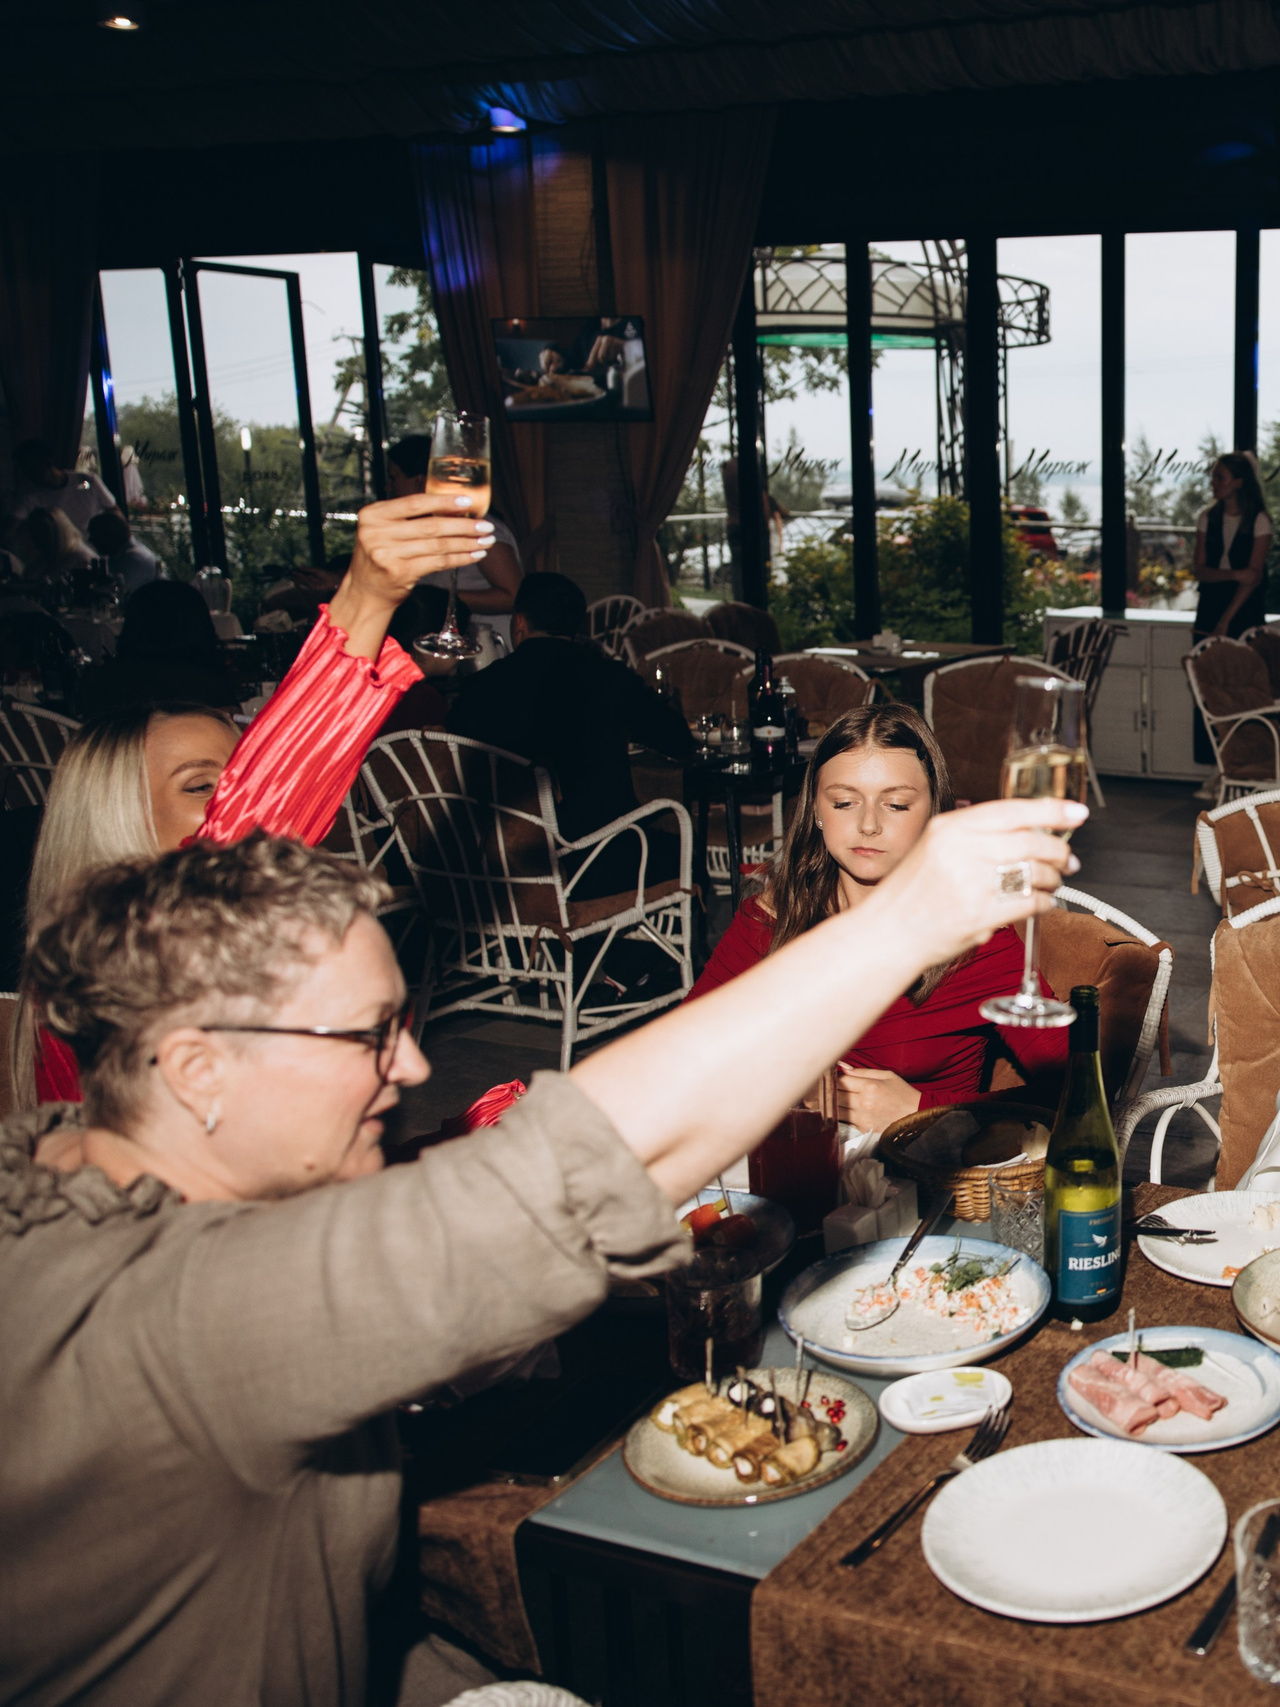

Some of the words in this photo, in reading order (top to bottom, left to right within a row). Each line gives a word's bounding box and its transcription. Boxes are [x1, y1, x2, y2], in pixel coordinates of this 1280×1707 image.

[767, 446, 843, 479] Мираж
[881, 447, 940, 482] Мир
[1008, 447, 1093, 482] Мираж
